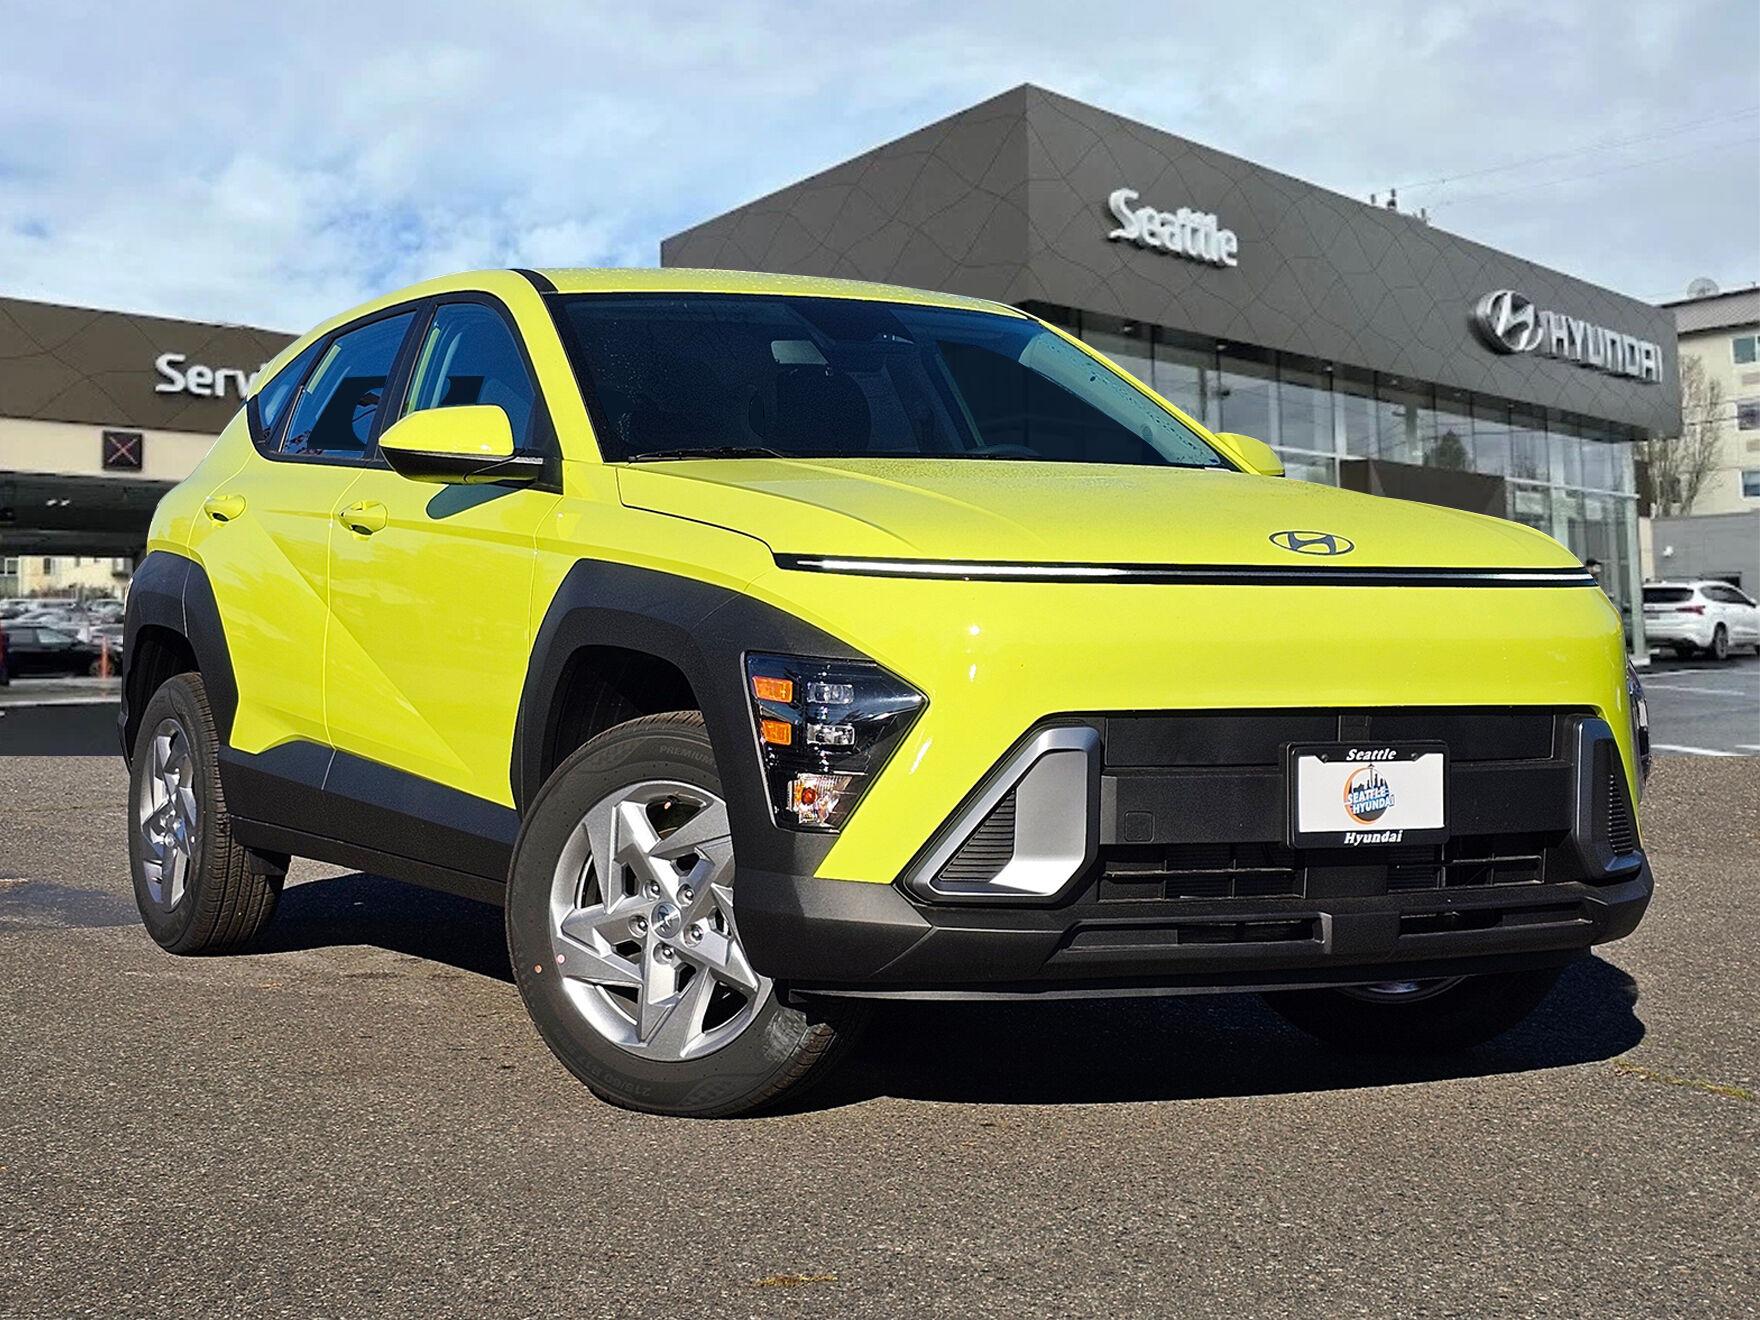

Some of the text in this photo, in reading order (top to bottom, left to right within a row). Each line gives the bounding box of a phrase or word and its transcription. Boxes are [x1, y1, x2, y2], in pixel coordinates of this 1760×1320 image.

[1108, 188, 1238, 267] Seattle
[1541, 311, 1663, 383] HYUNDAI
[155, 352, 267, 399] Serv
[1345, 748, 1397, 761] Seattle
[1347, 785, 1389, 804] SEATTLE
[1352, 793, 1396, 814] HYUNDAI
[1344, 830, 1403, 846] Hyundai
